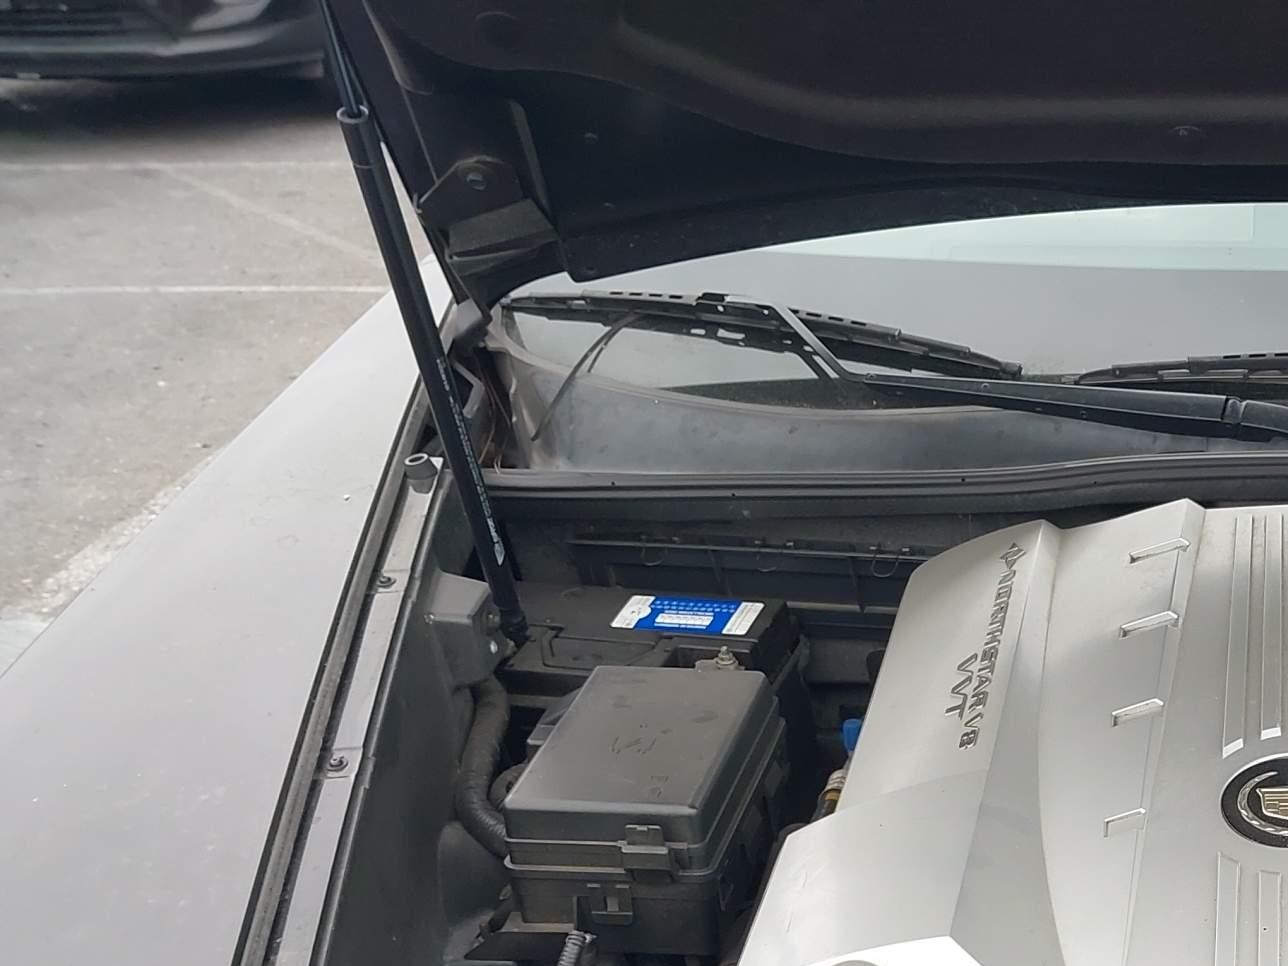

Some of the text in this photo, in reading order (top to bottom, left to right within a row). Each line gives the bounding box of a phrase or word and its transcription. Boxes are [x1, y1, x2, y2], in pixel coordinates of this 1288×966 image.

[944, 652, 978, 720] VVT
[958, 569, 1016, 750] NORTHSTAR V8
